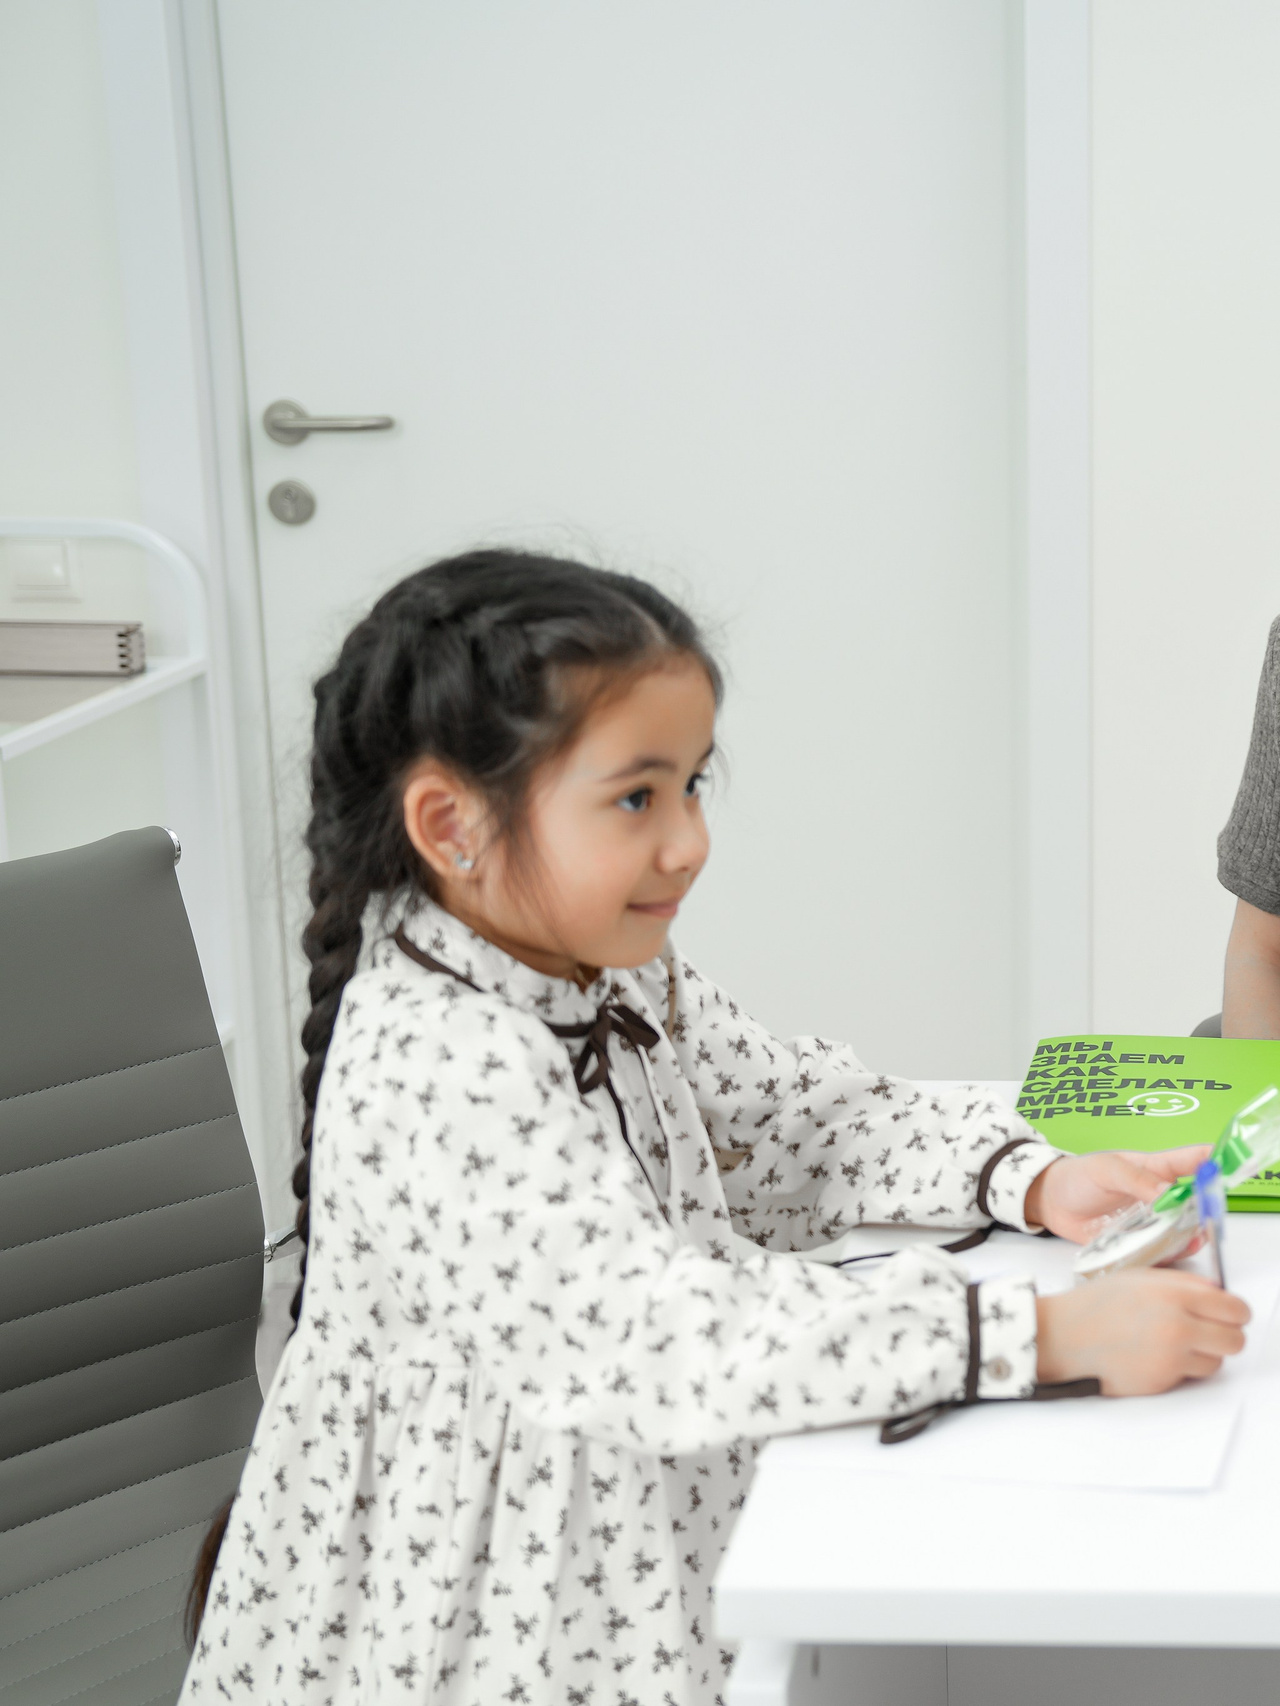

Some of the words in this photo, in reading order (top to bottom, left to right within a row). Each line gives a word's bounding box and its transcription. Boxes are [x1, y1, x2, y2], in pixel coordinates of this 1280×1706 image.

[1035, 1041, 1113, 1056] МЫ
[1030, 1053, 1185, 1067] ЗНАЕМ
[1026, 1065, 1119, 1081] КАК
[1021, 1078, 1233, 1094] СДЕЛАТЬ
[1016, 1091, 1119, 1108] МИР
[1018, 1104, 1147, 1120] ЯРЧЕ!
